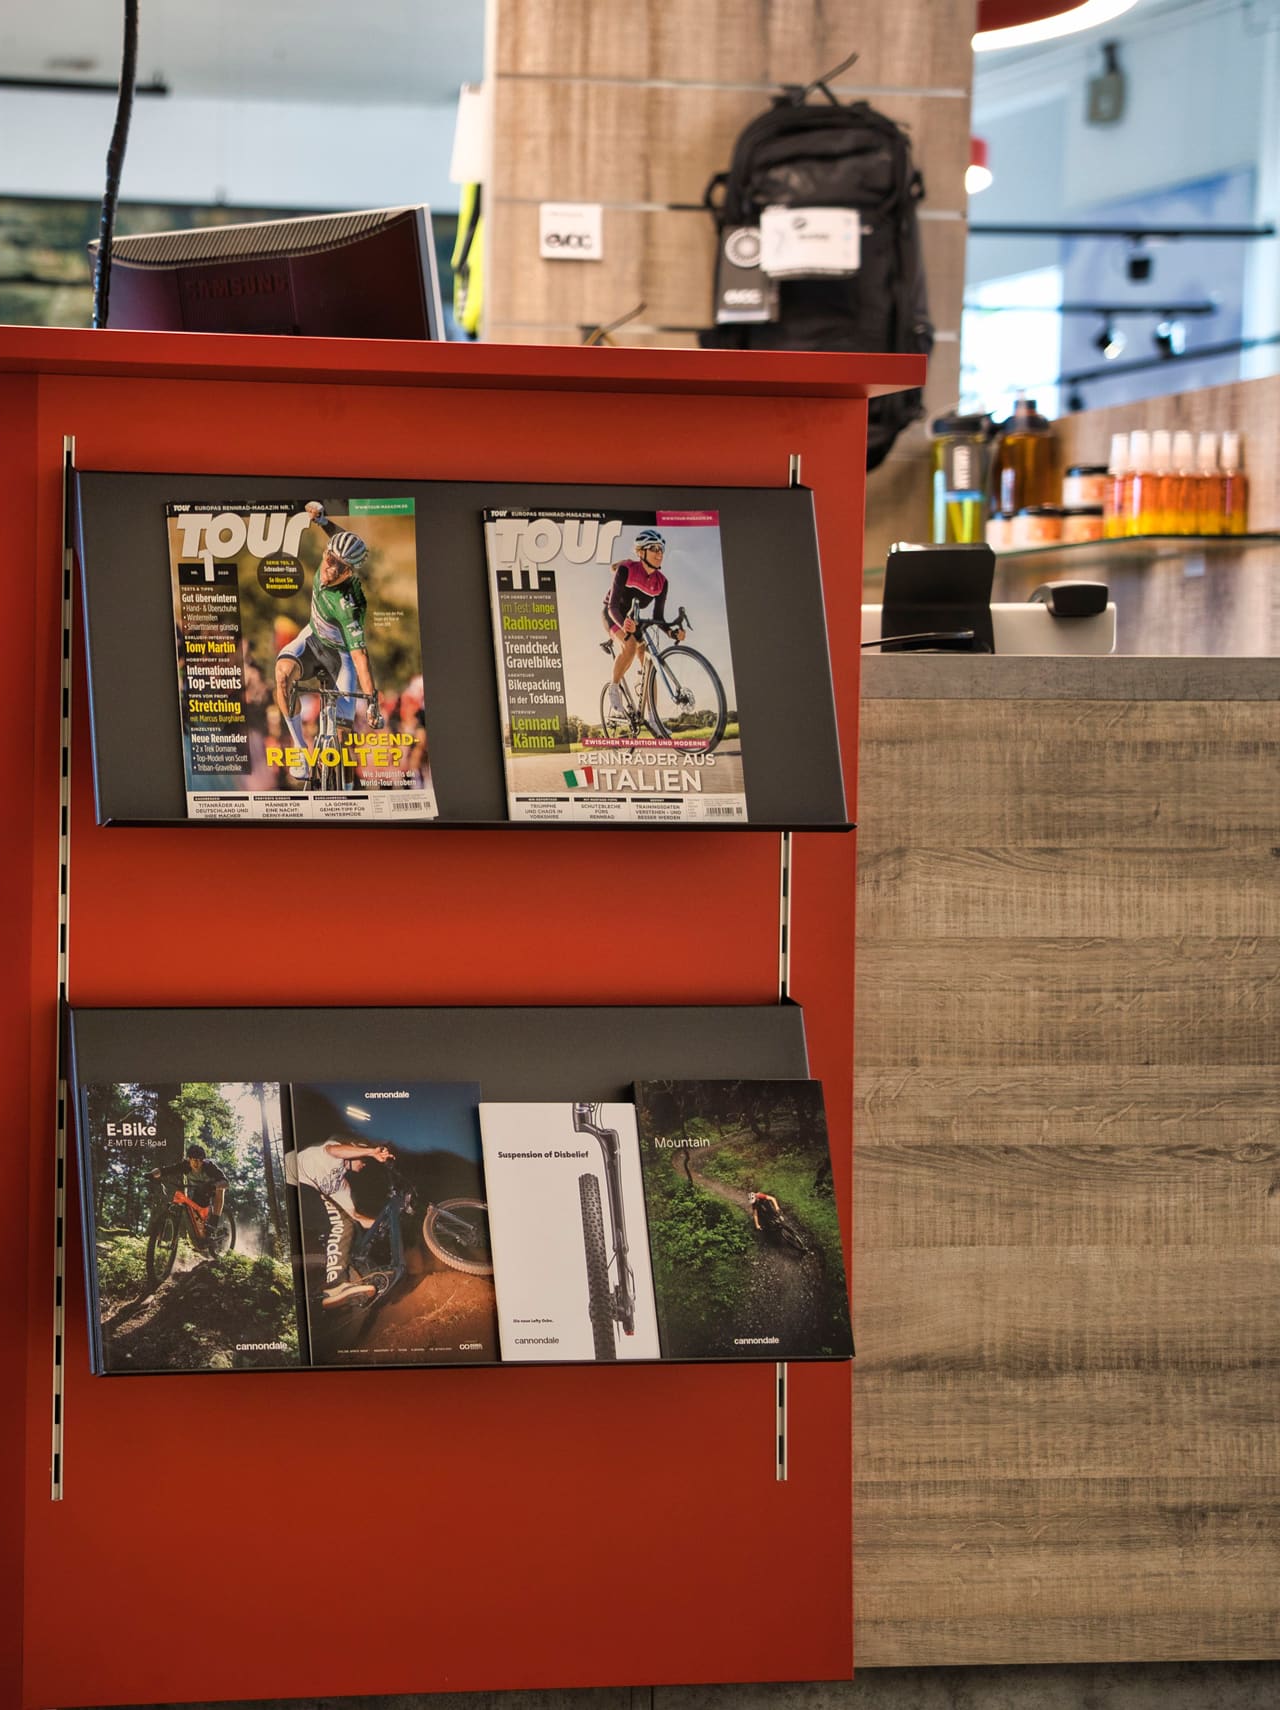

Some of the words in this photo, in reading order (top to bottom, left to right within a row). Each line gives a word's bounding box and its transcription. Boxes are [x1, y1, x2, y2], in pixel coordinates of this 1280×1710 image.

[186, 273, 288, 298] SAMSUNG
[182, 594, 194, 602] Gut
[195, 594, 237, 603] überwintern
[208, 604, 237, 612] Überschuhe
[533, 601, 554, 614] lange
[220, 624, 238, 632] günstig
[503, 616, 557, 630] Radhosen
[185, 641, 206, 654] Tony
[208, 641, 236, 653] Martin
[505, 642, 558, 654] Trendcheck
[506, 656, 561, 668] Gravelbikes
[186, 665, 242, 676] Internationale
[188, 676, 242, 690] Top-Events
[508, 679, 560, 692] Bikepacking
[510, 696, 516, 704] in
[517, 696, 527, 704] der
[529, 693, 564, 704] Toskana
[189, 700, 242, 714] Stretching
[218, 716, 246, 724] Burghardt
[512, 715, 560, 730] Lennard
[191, 734, 210, 743] Neue
[210, 734, 247, 743] Rennräder
[345, 733, 420, 746] JUGEND-
[513, 733, 555, 748] Kämna
[266, 747, 403, 767] REVOLTE?
[578, 750, 677, 766] RENNRÄDER
[683, 754, 715, 766] AUS
[593, 769, 702, 791] ITALIEN
[365, 1091, 409, 1099] cannondale
[106, 1122, 156, 1136] E-Bike
[654, 1137, 710, 1148] Mountain
[498, 1151, 542, 1160] Suspension
[236, 1342, 288, 1350] cannondale
[734, 1336, 780, 1344] cannondale
